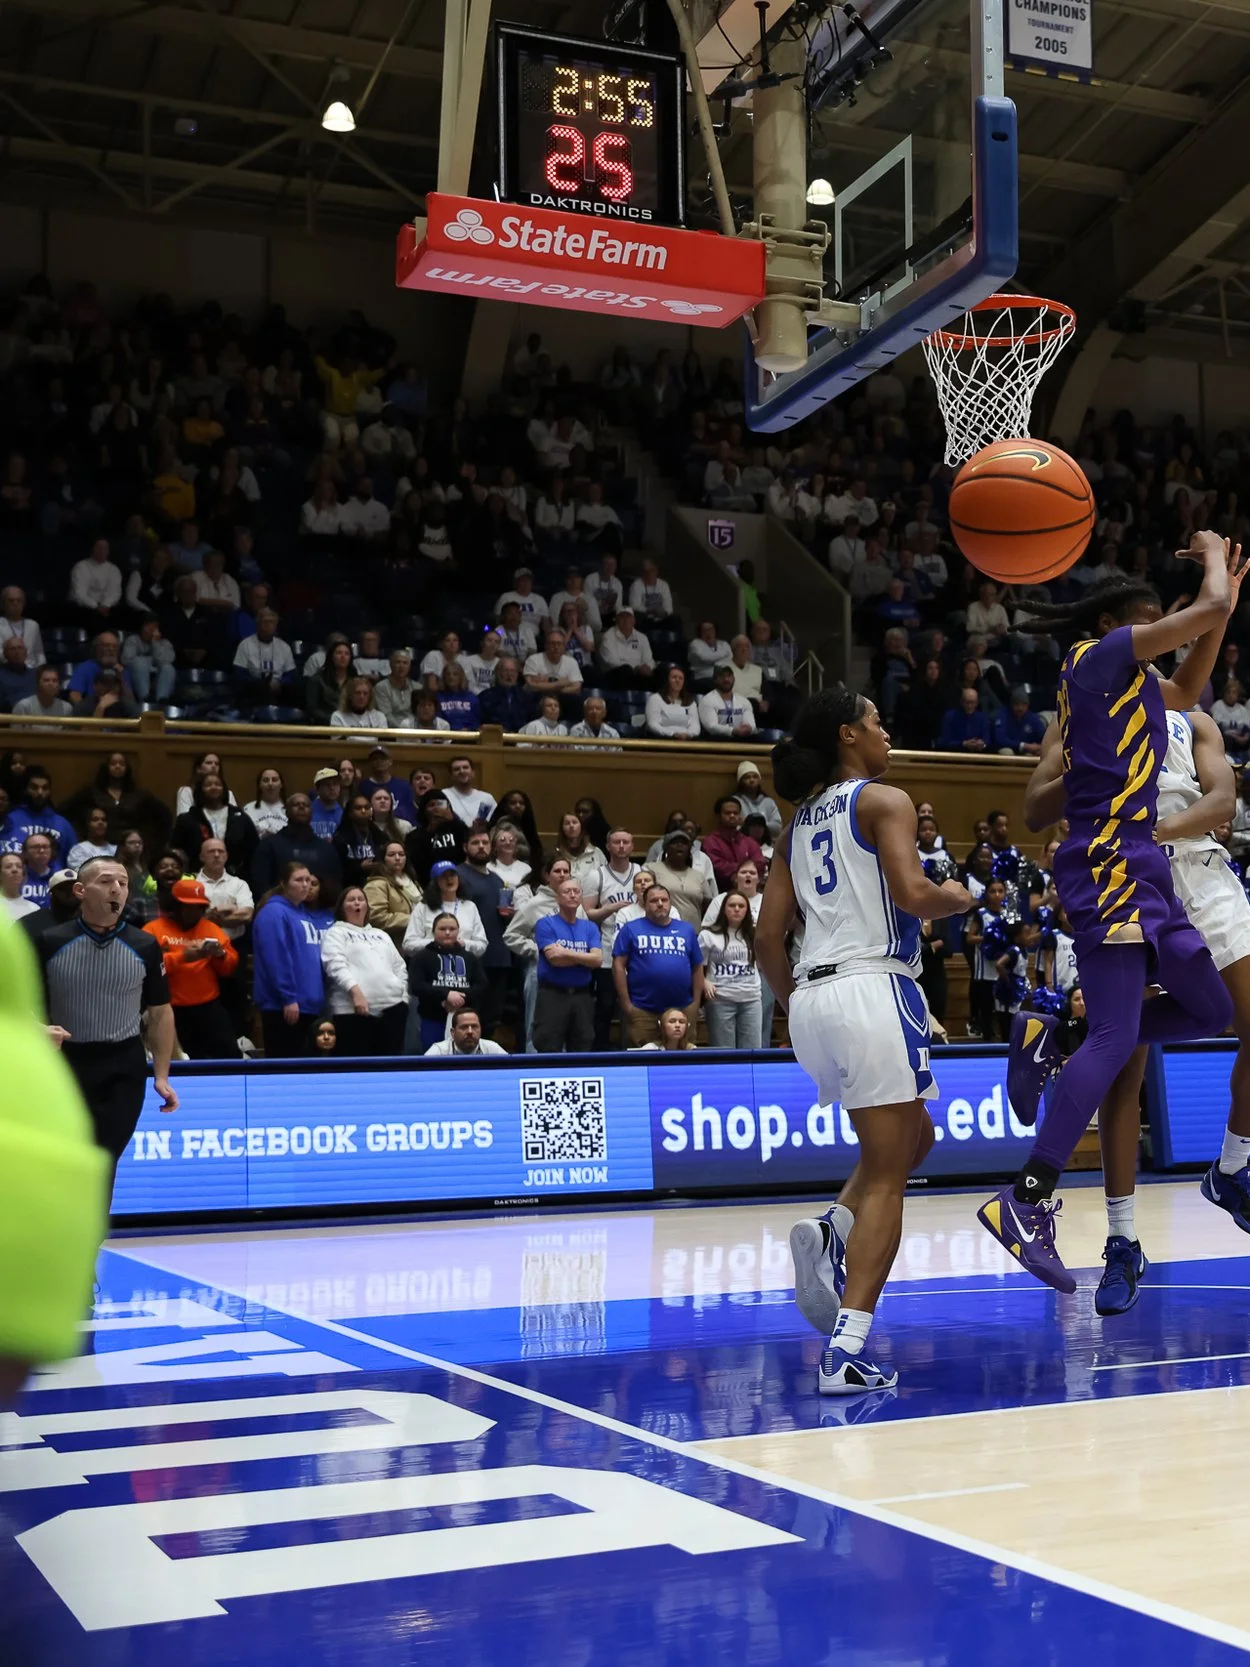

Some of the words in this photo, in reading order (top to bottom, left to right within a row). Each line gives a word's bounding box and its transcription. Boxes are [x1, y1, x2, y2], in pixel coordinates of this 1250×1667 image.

[1015, 0, 1086, 21] CHAMPIONS
[1027, 18, 1074, 34] TOURNAMENT
[1034, 36, 1068, 55] 2005
[552, 66, 653, 128] 2:55
[546, 125, 632, 199] 25
[530, 193, 653, 220] DAKTRONICS
[713, 527, 732, 546] 15
[795, 793, 848, 827] JACKSON
[811, 829, 838, 896] 3
[637, 935, 686, 951] DUKE
[133, 1129, 173, 1161] IN
[182, 1123, 357, 1159] FACEBOOK
[366, 1120, 494, 1152] GROUPS
[523, 1167, 565, 1187] JOIN
[569, 1166, 609, 1184] NOW
